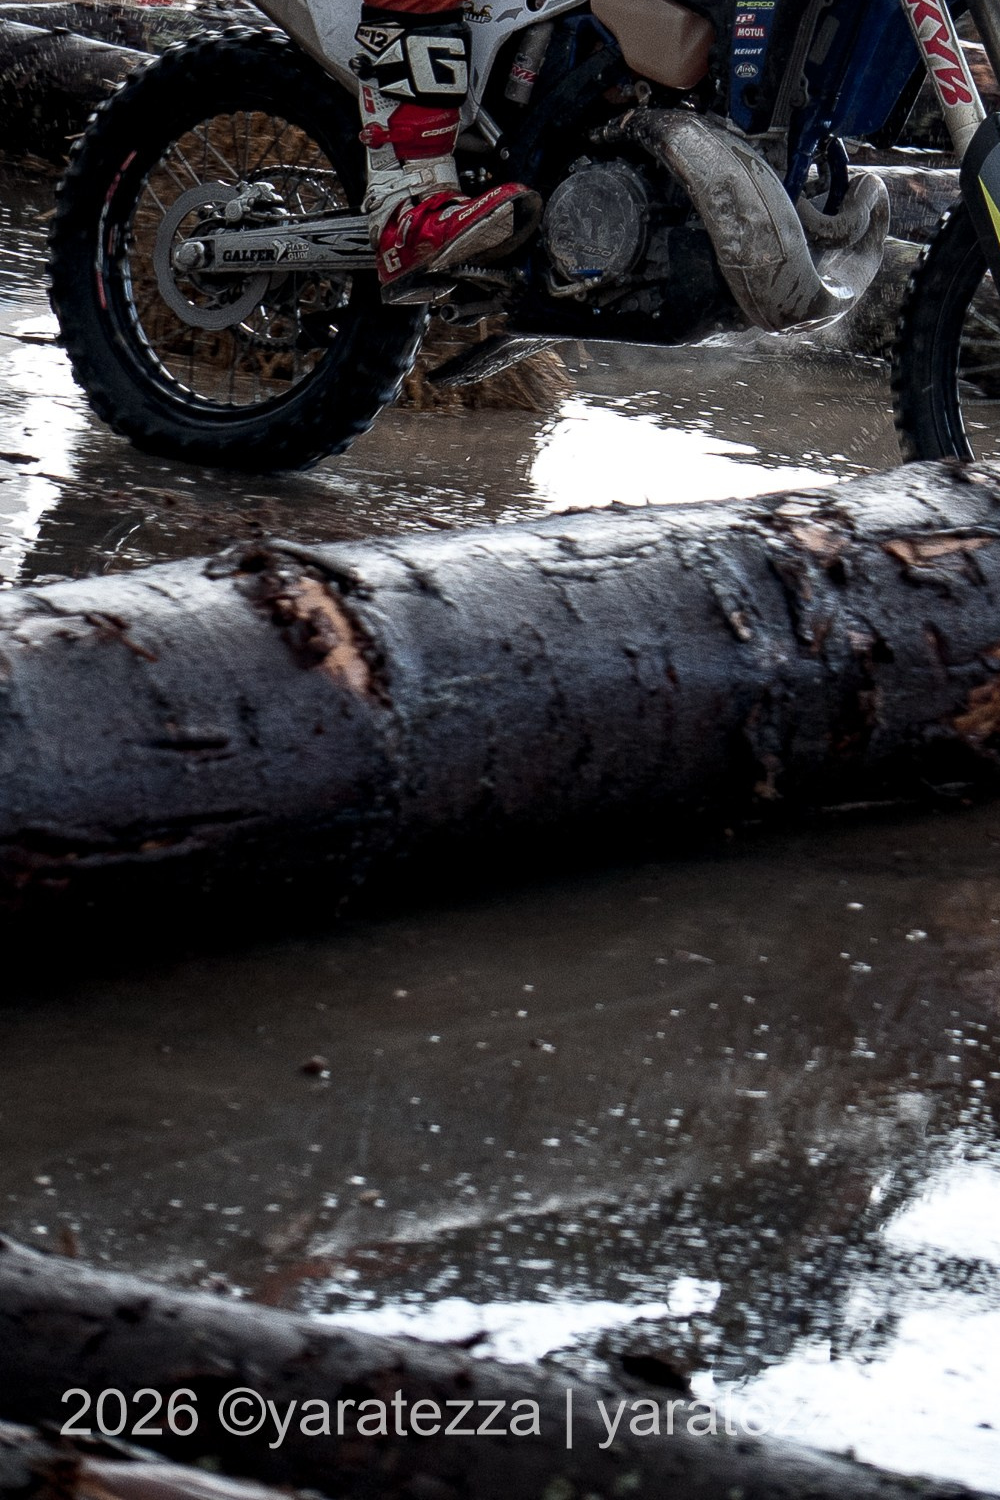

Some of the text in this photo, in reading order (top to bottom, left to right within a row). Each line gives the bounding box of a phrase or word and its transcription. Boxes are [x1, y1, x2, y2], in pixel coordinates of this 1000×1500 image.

[737, 27, 765, 37] MOTUL
[405, 35, 468, 97] G
[223, 250, 276, 262] GALFER
